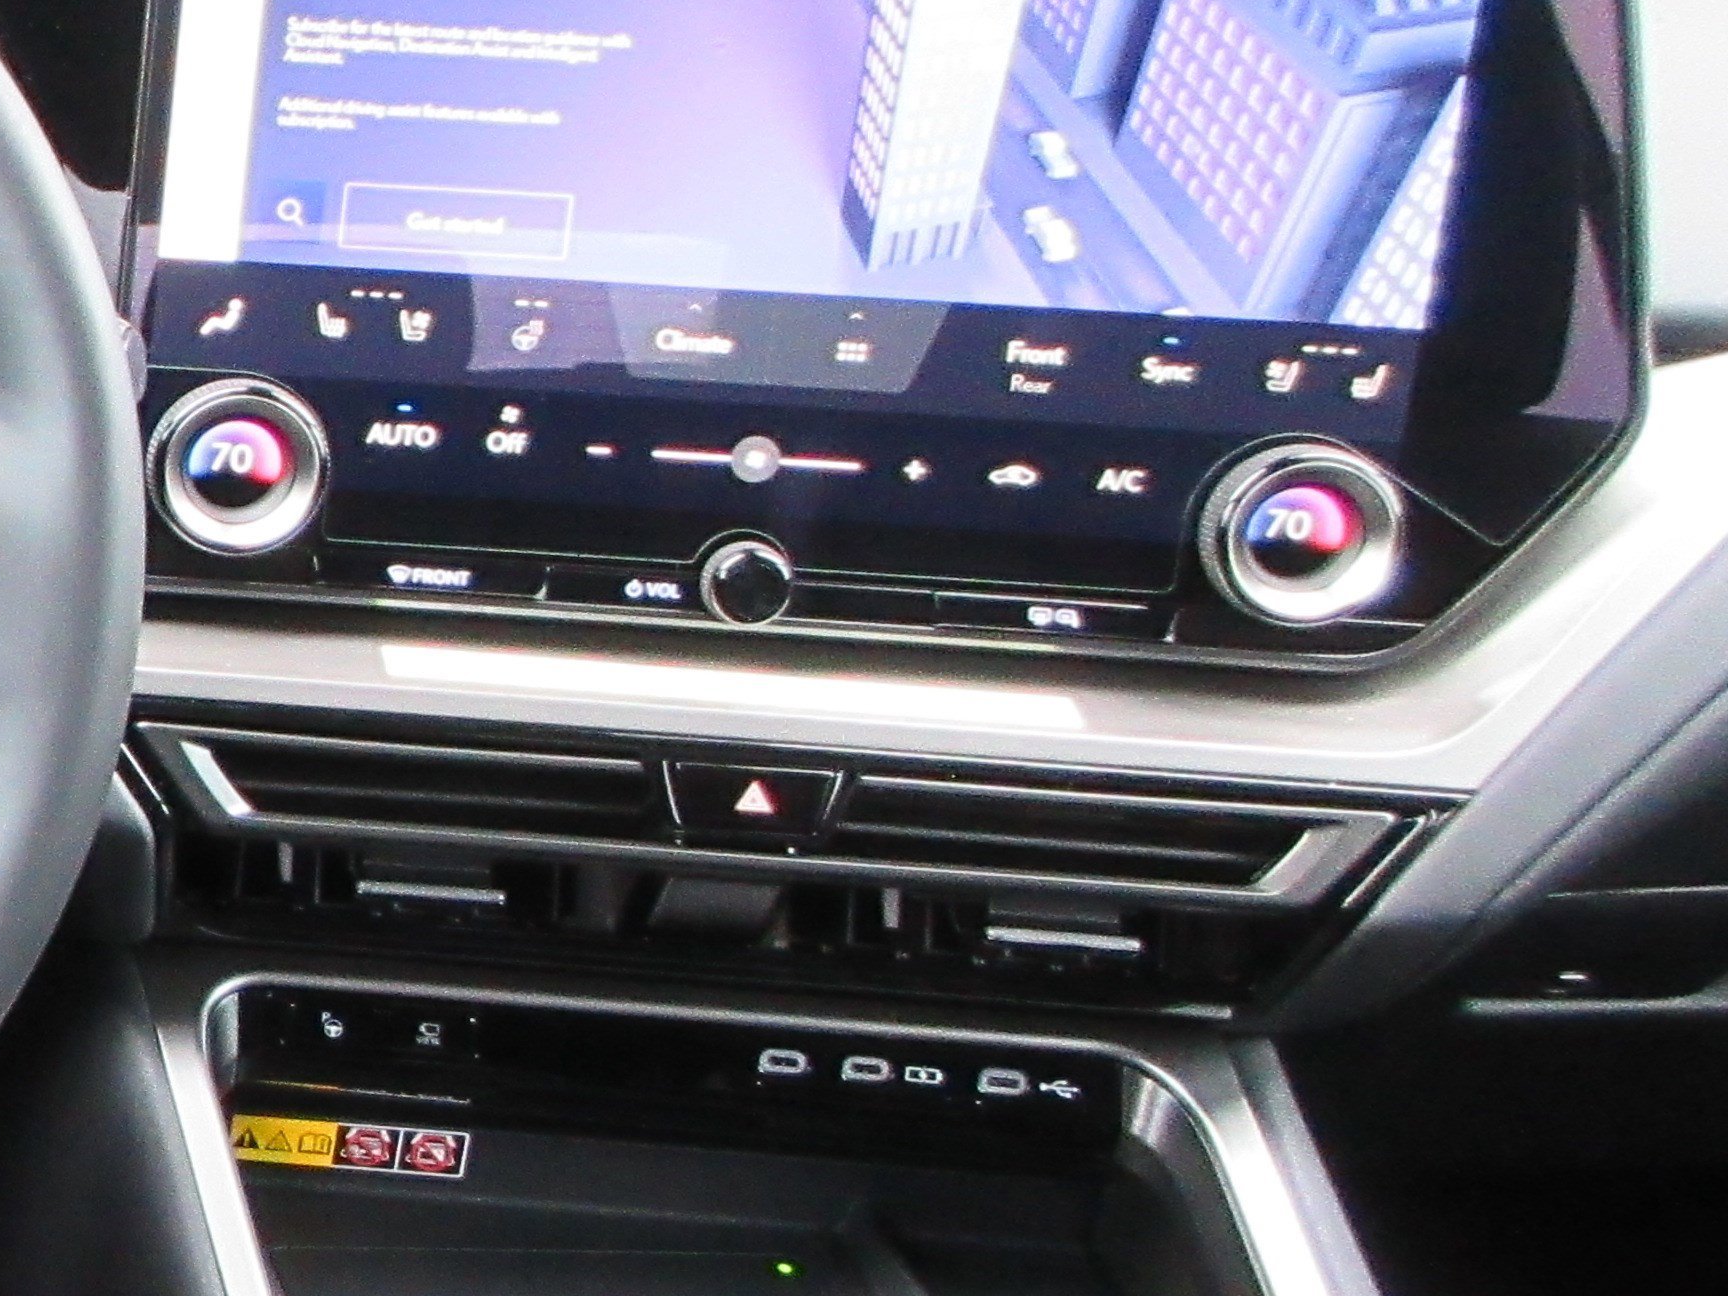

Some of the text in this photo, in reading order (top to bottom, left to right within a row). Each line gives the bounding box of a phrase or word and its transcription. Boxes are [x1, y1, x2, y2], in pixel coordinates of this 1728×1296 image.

[654, 327, 734, 356] Climate
[1005, 339, 1069, 366] Front
[1141, 355, 1198, 384] Sync
[1008, 373, 1053, 394] Rear
[365, 421, 438, 450] AUTO
[485, 430, 531, 455] Off
[210, 441, 254, 475] 70
[1095, 467, 1148, 494] A/C
[1263, 508, 1314, 541] 70
[411, 566, 473, 587] FRONT
[645, 581, 681, 600] VOL
